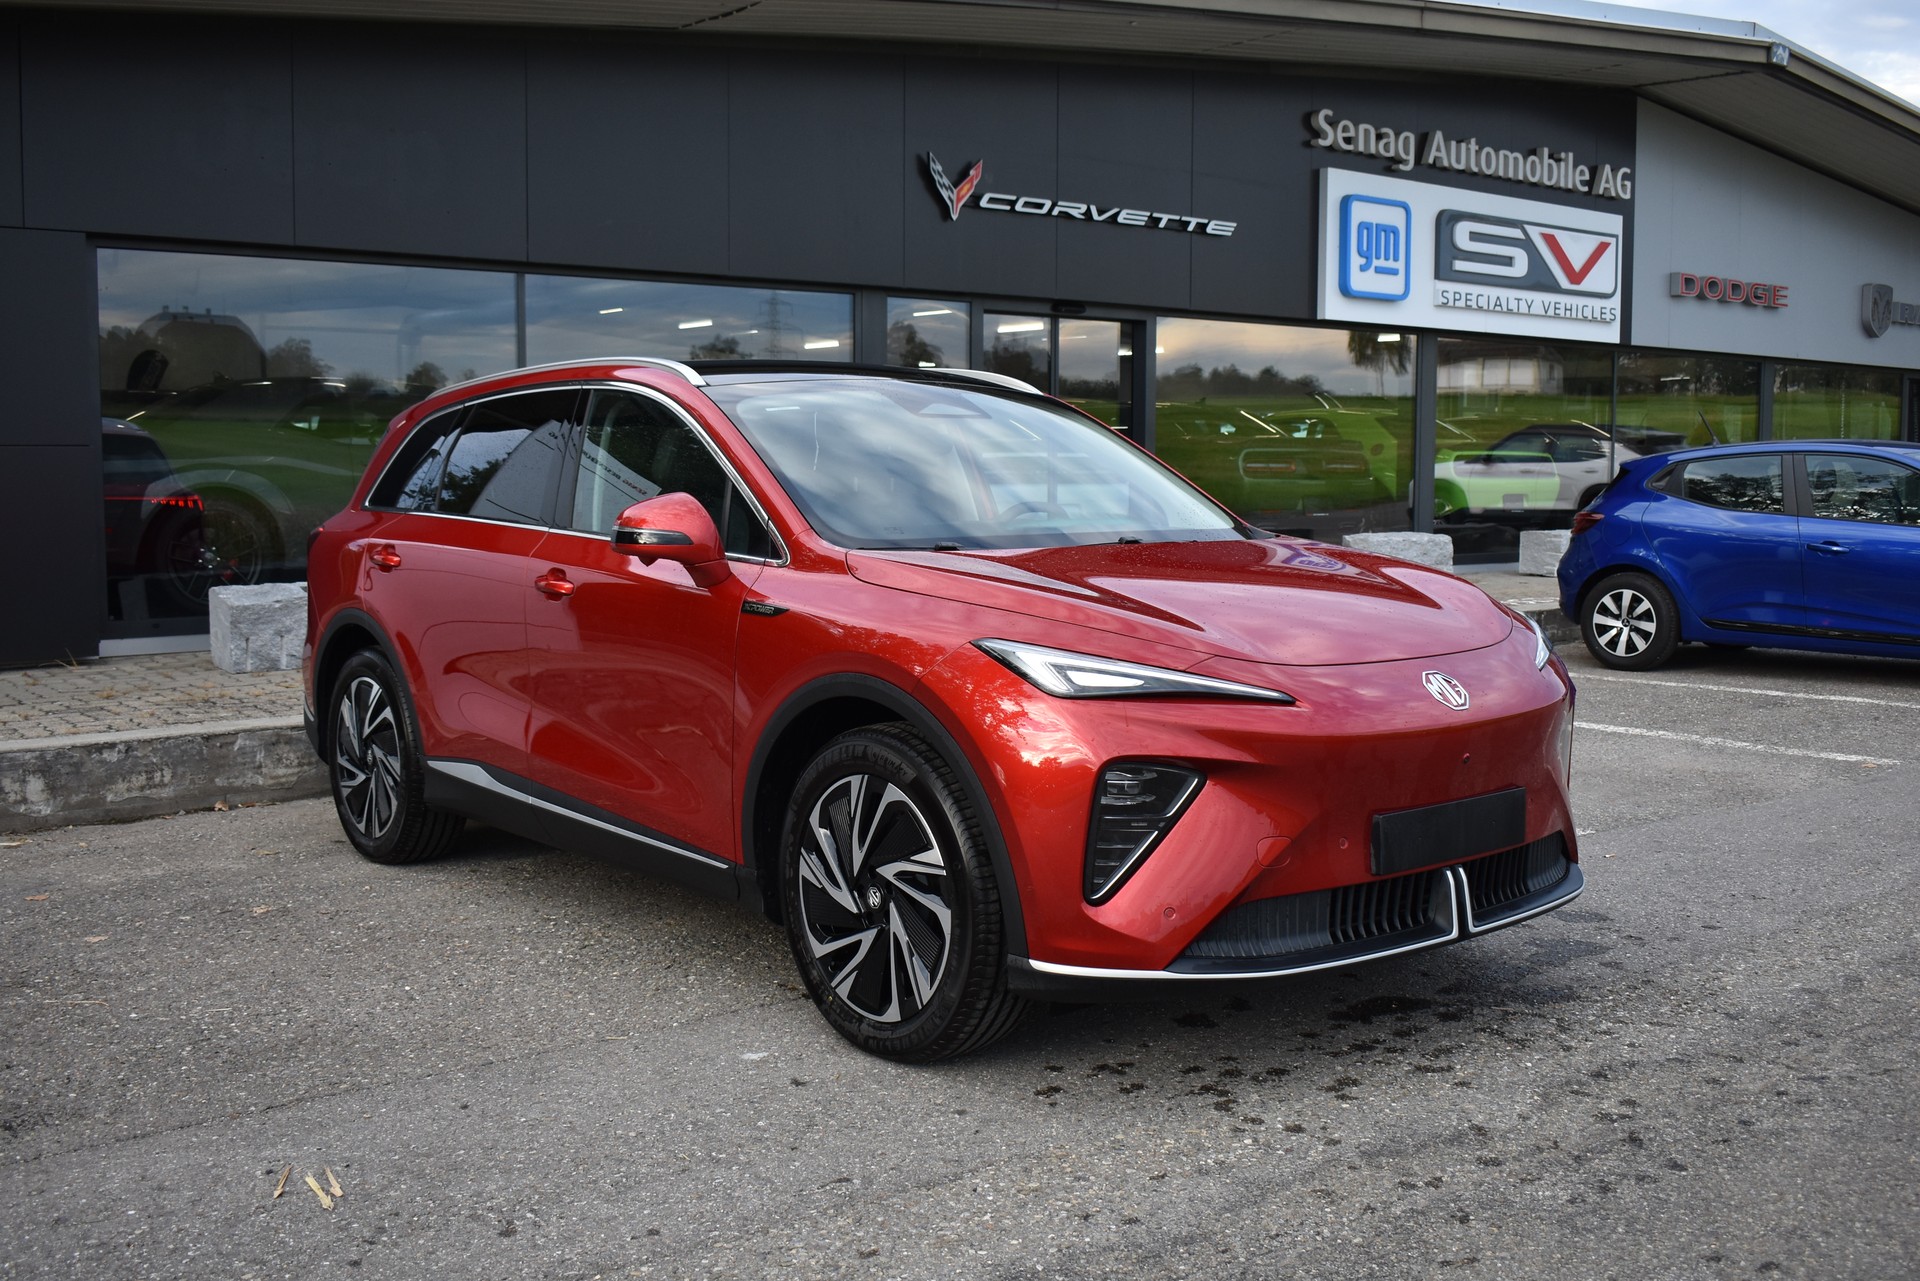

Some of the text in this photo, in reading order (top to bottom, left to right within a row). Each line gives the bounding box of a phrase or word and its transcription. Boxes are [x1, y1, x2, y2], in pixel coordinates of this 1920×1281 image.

[1314, 108, 1632, 200] Senag Automobile AG
[979, 192, 1237, 237] CORVETTE
[1356, 220, 1401, 275] gm
[1440, 289, 1617, 322] SPECIALTY VEHICLES
[1678, 272, 1789, 308] DODGE
[1425, 672, 1467, 708] MG
